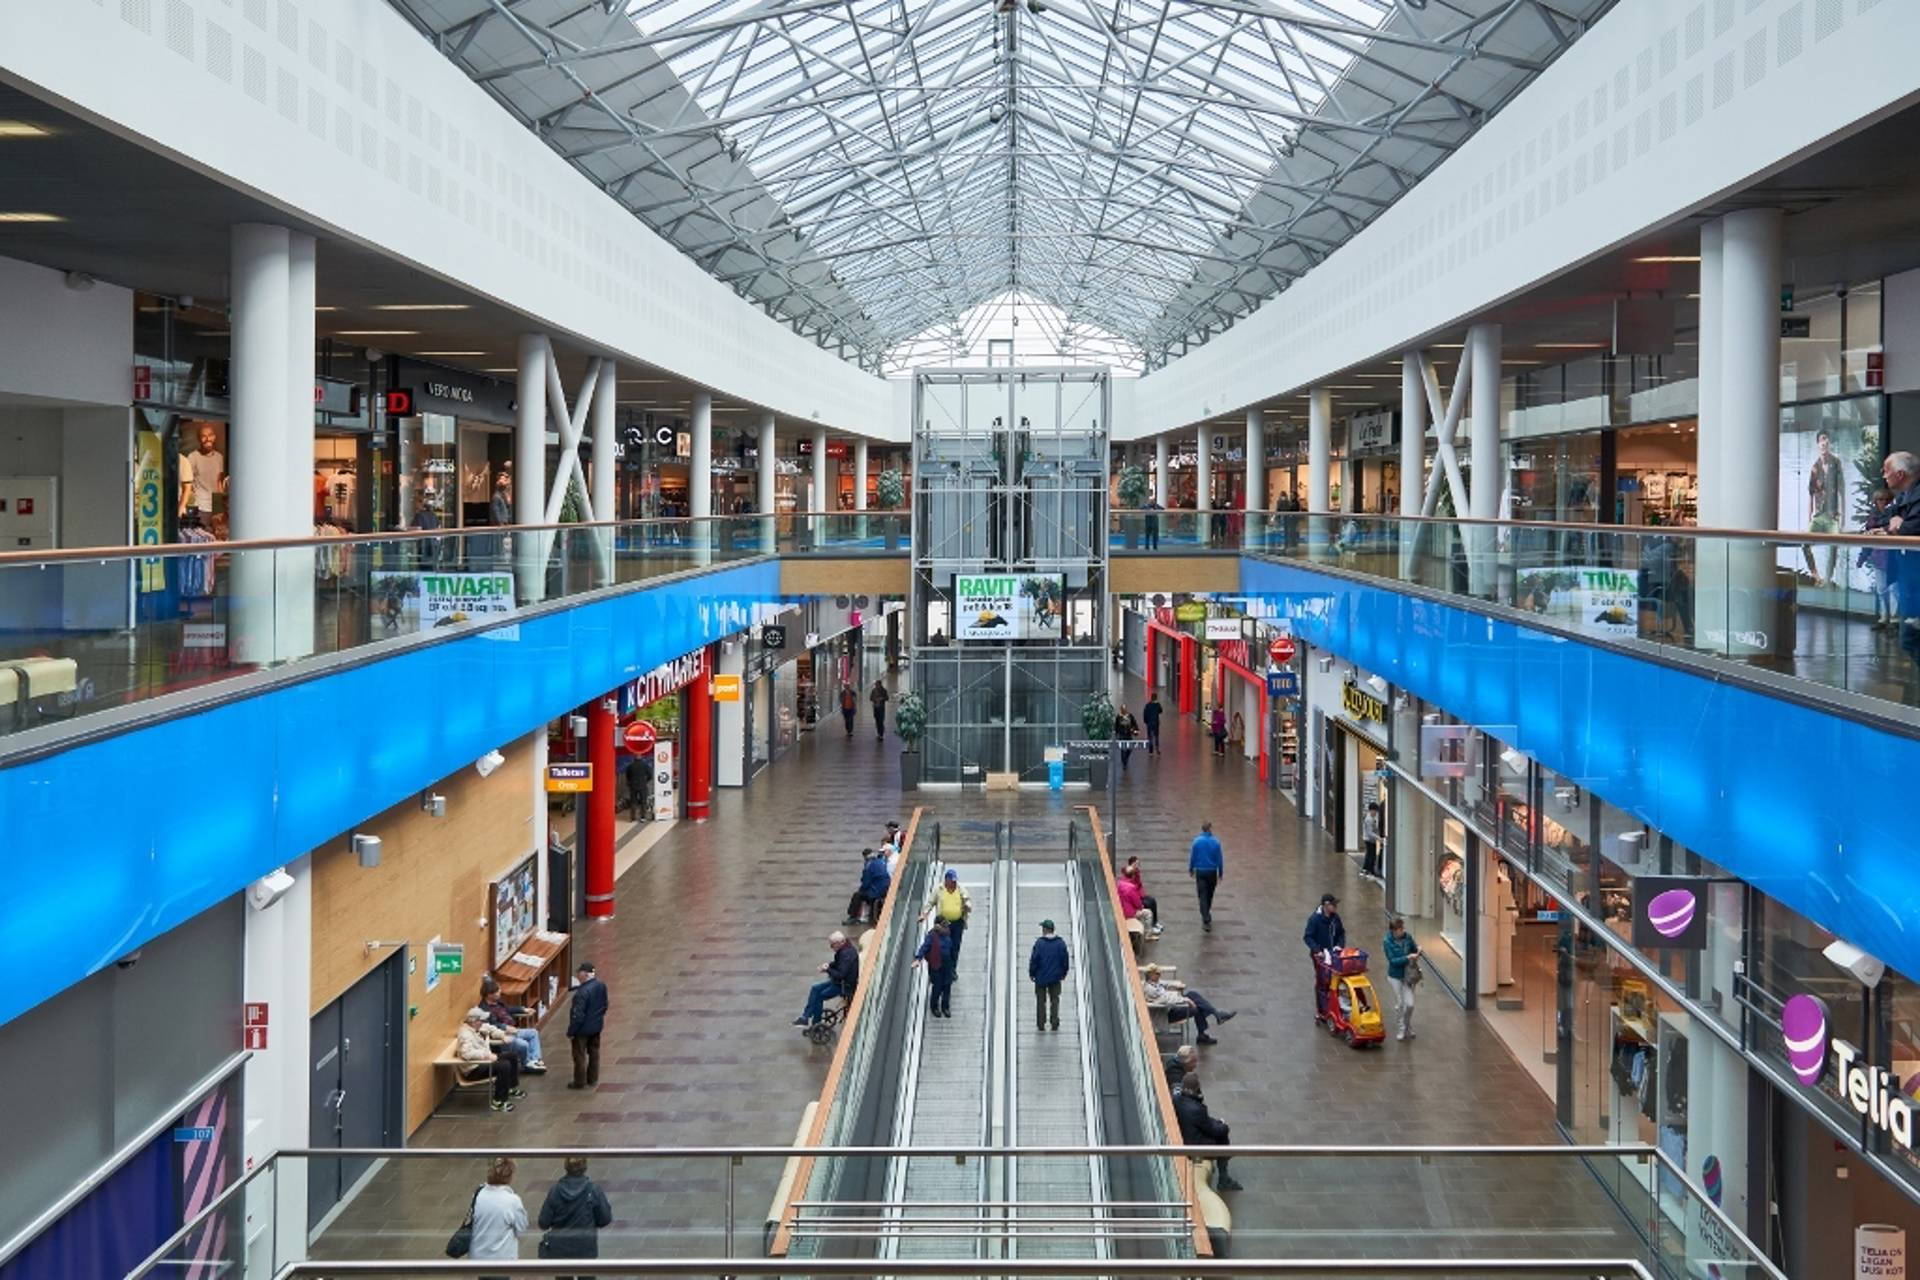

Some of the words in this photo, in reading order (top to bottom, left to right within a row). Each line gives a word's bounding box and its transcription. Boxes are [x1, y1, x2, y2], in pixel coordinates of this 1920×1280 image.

[142, 482, 159, 518] 3
[960, 578, 1016, 596] RAVIT
[636, 646, 706, 708] CITYMARKET
[1832, 1037, 1912, 1148] Telia
[194, 1129, 211, 1140] 107
